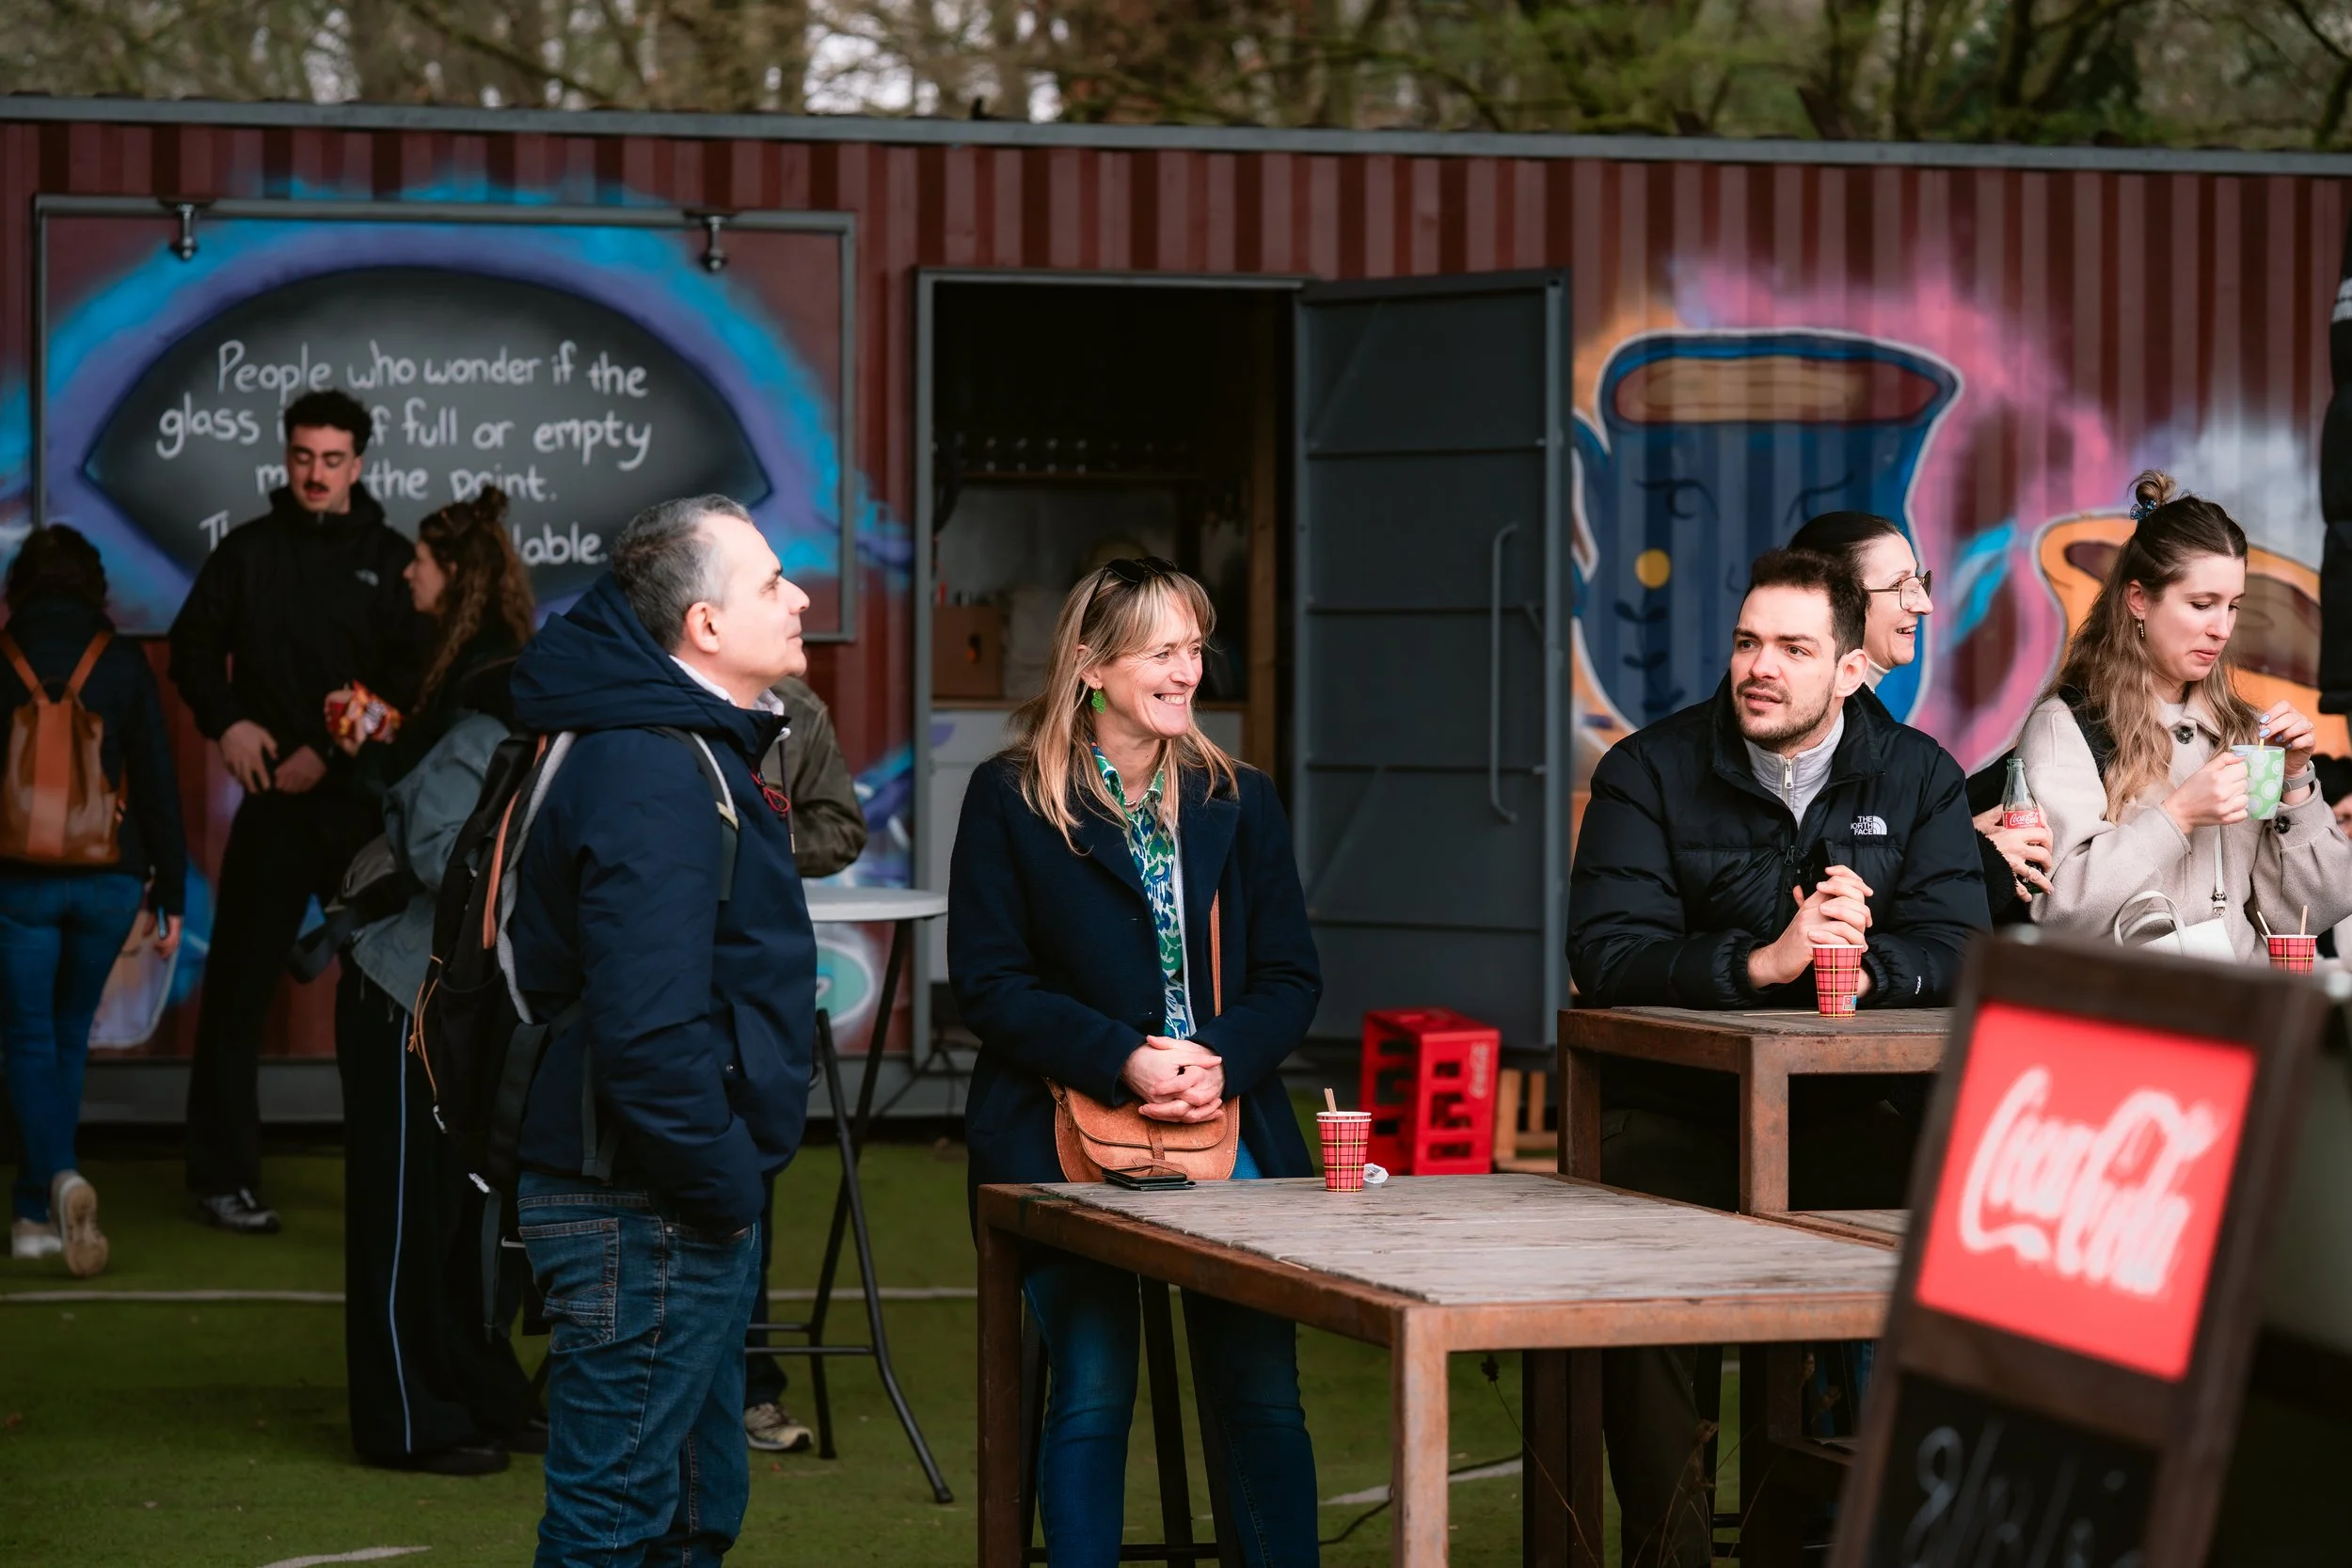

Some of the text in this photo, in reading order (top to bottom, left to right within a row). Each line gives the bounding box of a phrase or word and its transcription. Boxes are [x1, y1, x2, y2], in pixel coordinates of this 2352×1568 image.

[217, 340, 649, 405] People who wonder if the
[156, 391, 261, 459] glass
[402, 397, 458, 447] full
[471, 420, 515, 450] or
[533, 408, 651, 470] empty
[362, 458, 429, 500] the
